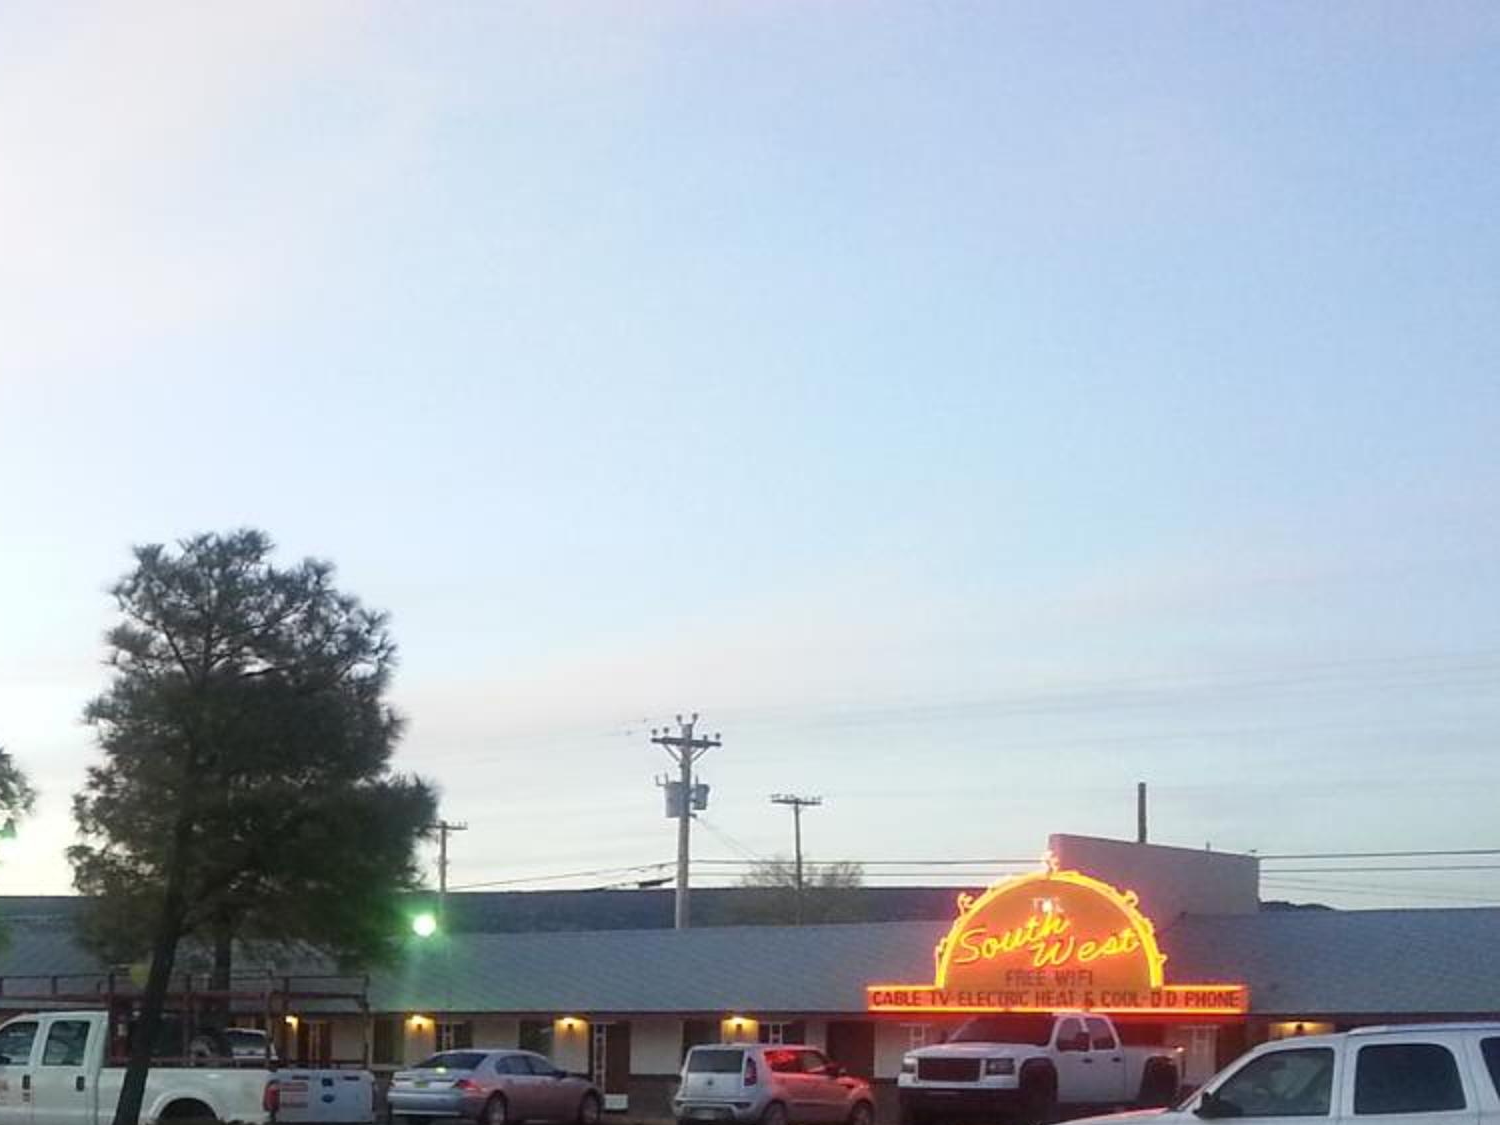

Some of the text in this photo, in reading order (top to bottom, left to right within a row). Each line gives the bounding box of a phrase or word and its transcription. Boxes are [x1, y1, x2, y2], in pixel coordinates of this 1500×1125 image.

[954, 914, 1072, 963] South
[1029, 928, 1141, 967] West
[1005, 970, 1046, 986] FREE
[872, 991, 922, 1007] CABLE
[931, 991, 949, 1006] TV
[958, 991, 1029, 1007] ELECTRIC
[1036, 991, 1075, 1008] HEAT
[1185, 991, 1239, 1007] PHONE
